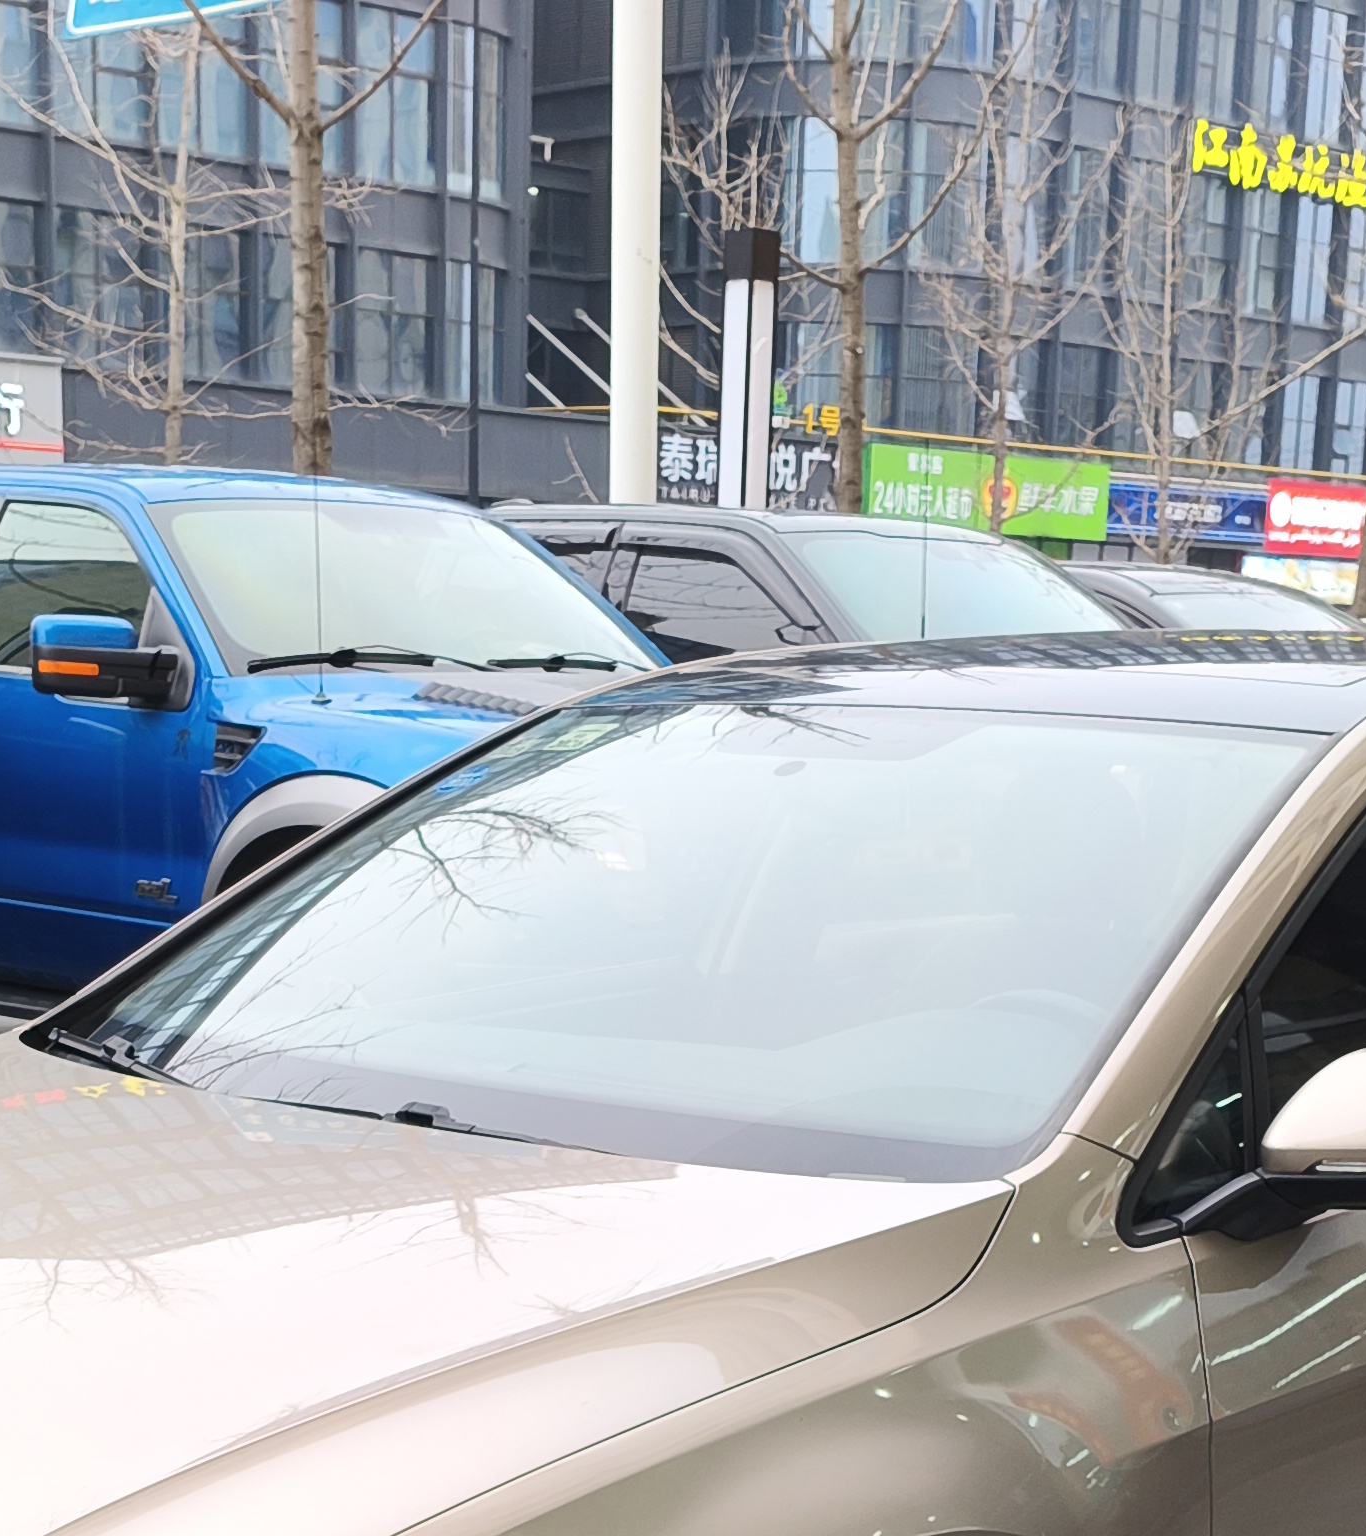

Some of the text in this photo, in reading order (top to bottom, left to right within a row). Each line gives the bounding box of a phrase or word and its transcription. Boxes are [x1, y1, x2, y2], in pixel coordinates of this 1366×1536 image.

[873, 481, 973, 520] 24小时无人超市
